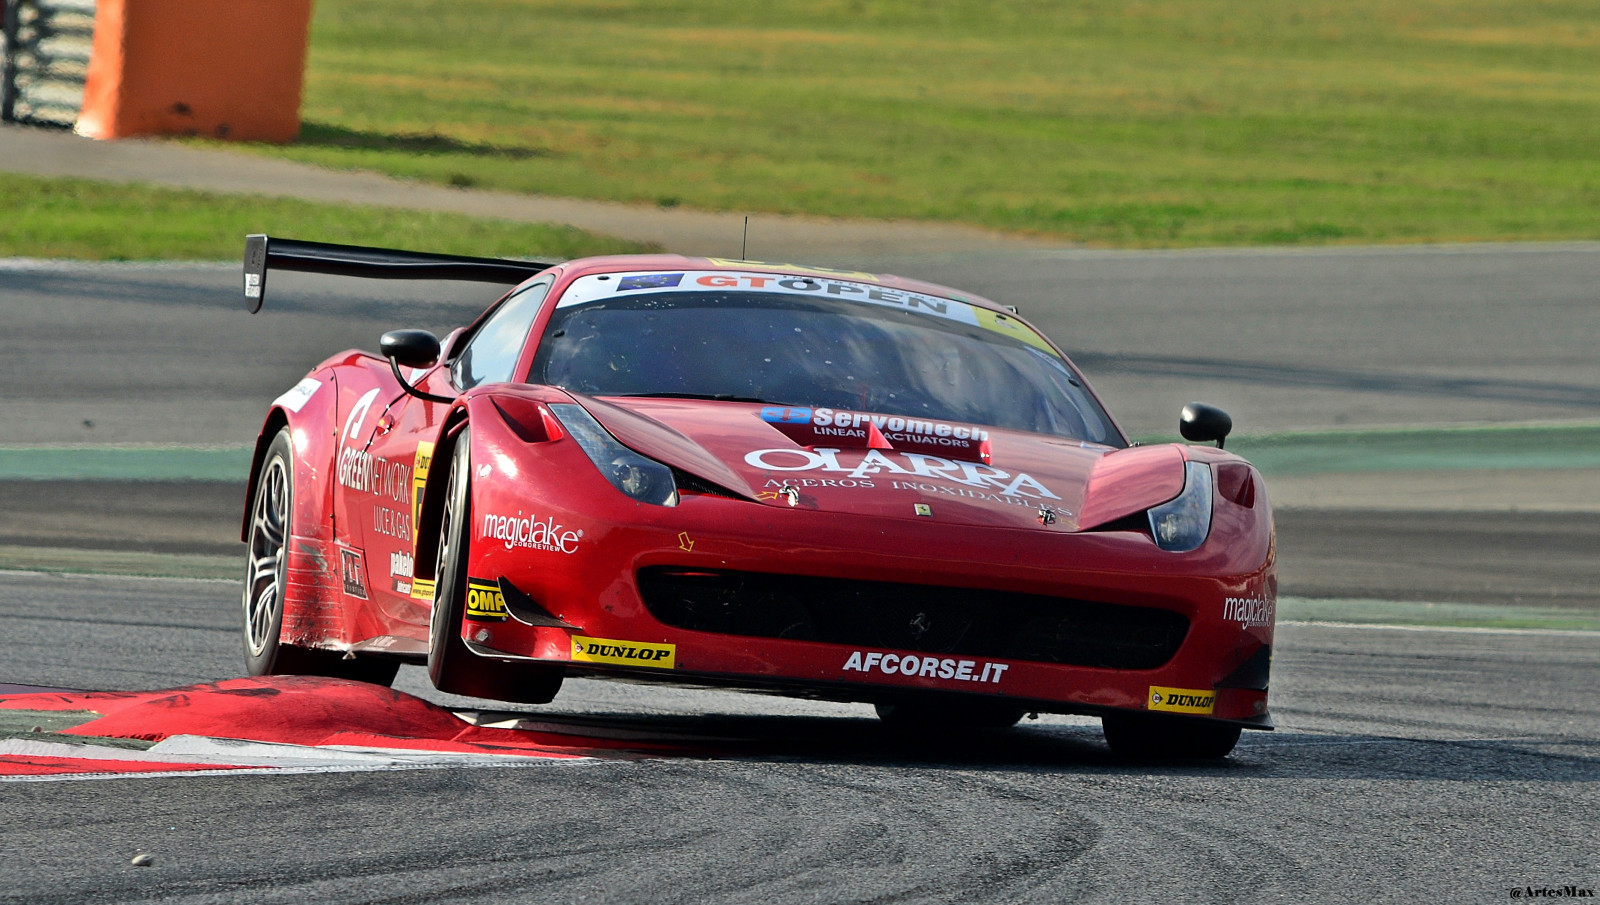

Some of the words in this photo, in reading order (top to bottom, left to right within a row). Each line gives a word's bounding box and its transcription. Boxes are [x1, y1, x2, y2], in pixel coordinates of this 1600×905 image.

[813, 407, 989, 442] Servomech
[814, 426, 866, 439] LINEAR
[884, 431, 971, 448] ACTUATORS
[744, 447, 1063, 500] OLARRA
[763, 477, 876, 489] ACEROS
[892, 480, 1073, 516] INOXIDABLES
[373, 504, 390, 535] LUCE
[390, 509, 397, 537] &
[397, 511, 411, 541] GAS
[513, 540, 561, 553] COMOREVIEW
[467, 589, 505, 612] OMP
[586, 643, 671, 661] DUNLOP
[843, 651, 1008, 683] AFCORSE.IT
[1165, 693, 1215, 708] DUNLOP
